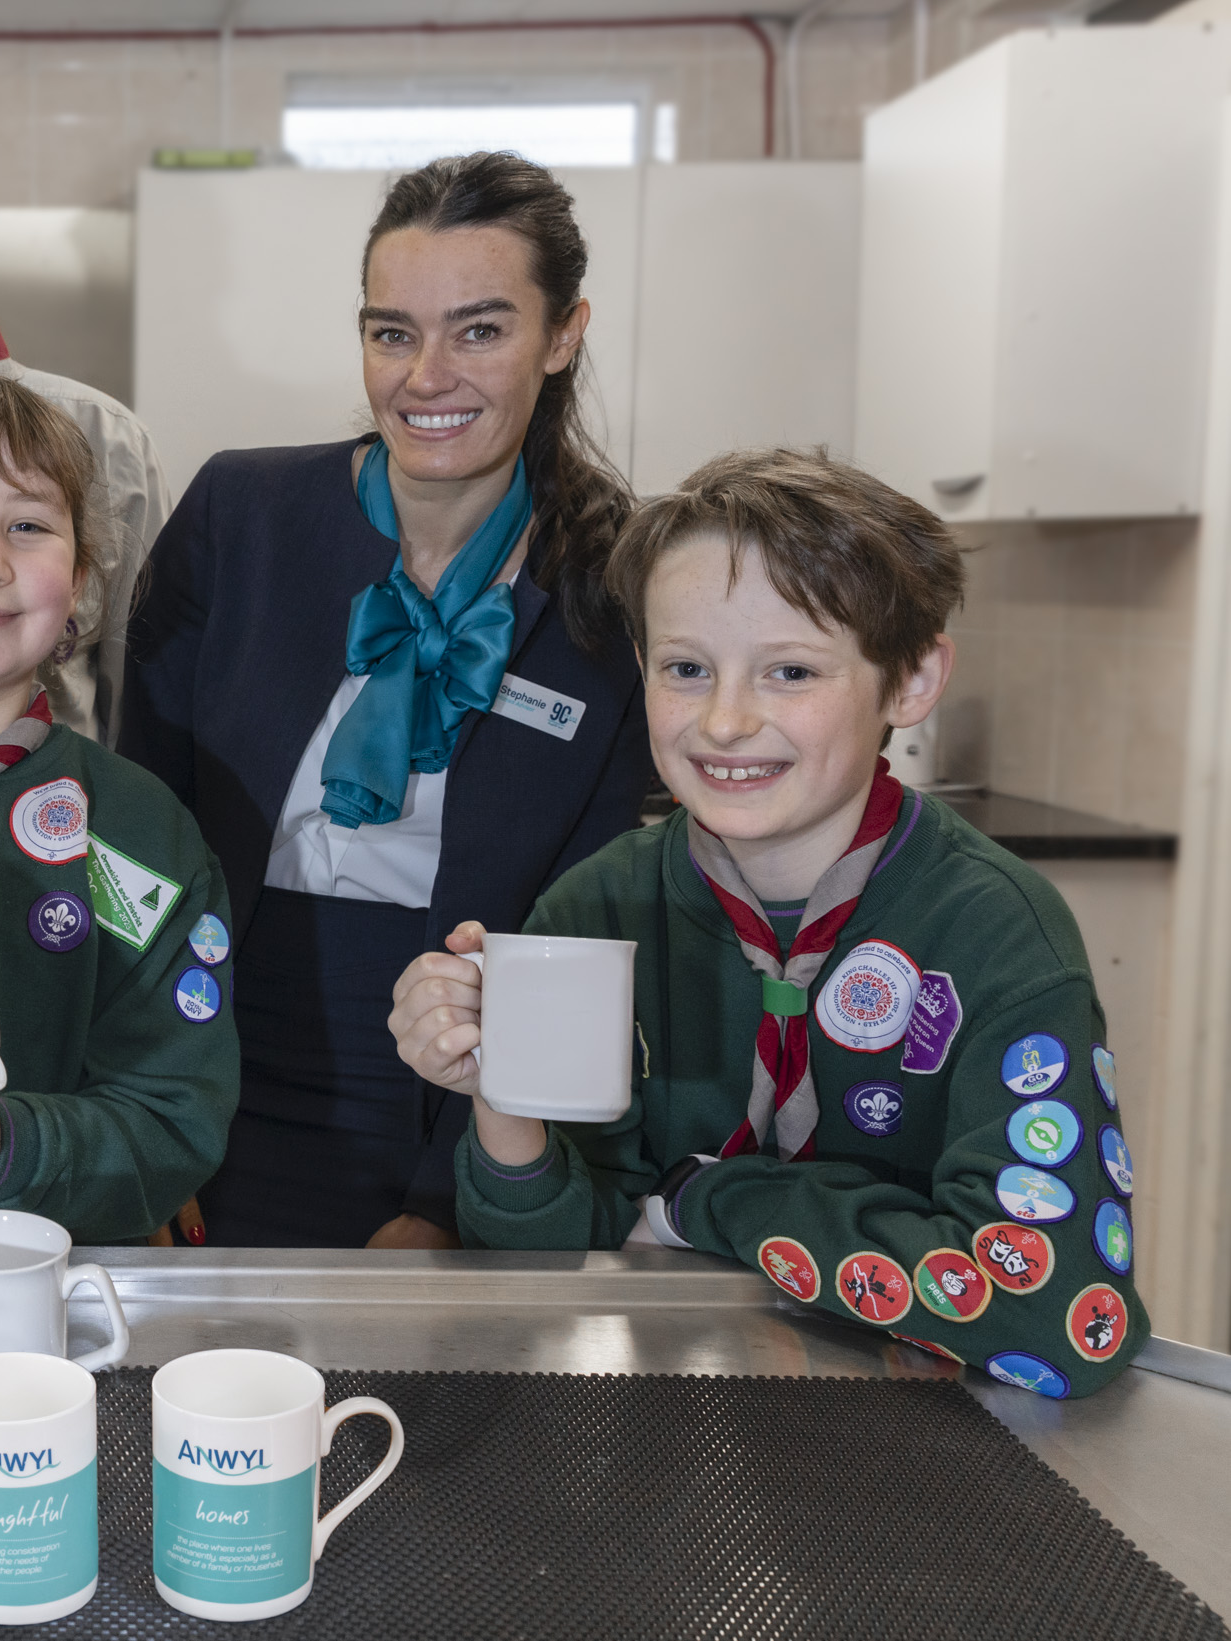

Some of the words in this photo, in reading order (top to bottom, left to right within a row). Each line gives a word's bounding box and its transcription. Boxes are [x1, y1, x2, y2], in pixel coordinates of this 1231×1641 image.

[500, 685, 547, 709] Stephanie
[39, 797, 53, 807] KING
[32, 811, 52, 840] CORONATION
[92, 858, 101, 874] The
[99, 875, 121, 912] Gathering
[100, 853, 121, 887] Ormskirk
[118, 887, 130, 902] and
[126, 901, 143, 928] District
[857, 946, 875, 954] proud
[884, 951, 911, 974] celebrate
[842, 966, 857, 979] KING
[858, 964, 891, 982] CHARLES
[889, 981, 897, 990] III
[184, 1004, 202, 1017] NAVY
[186, 999, 202, 1010] ROYAL
[834, 984, 856, 1025] CORONATION
[880, 1012, 894, 1024] MAY
[892, 997, 900, 1013] 2023
[912, 1019, 930, 1039] Patron
[914, 1033, 935, 1053] Queen
[1027, 1073, 1044, 1083] GO
[1016, 1209, 1036, 1219] sta
[927, 1282, 947, 1305] pets
[195, 1500, 251, 1526] homes
[7, 1542, 61, 1556] consideration
[177, 1535, 188, 1545] the
[189, 1539, 209, 1550] place
[210, 1544, 236, 1553] where
[254, 1544, 272, 1552] lives
[0, 1556, 13, 1565] the
[13, 1556, 39, 1565] needs
[40, 1553, 50, 1563] of
[192, 1560, 200, 1568] of
[207, 1562, 232, 1574] family
[233, 1565, 243, 1573] or
[243, 1557, 284, 1572] household
[219, 1554, 259, 1564] especially
